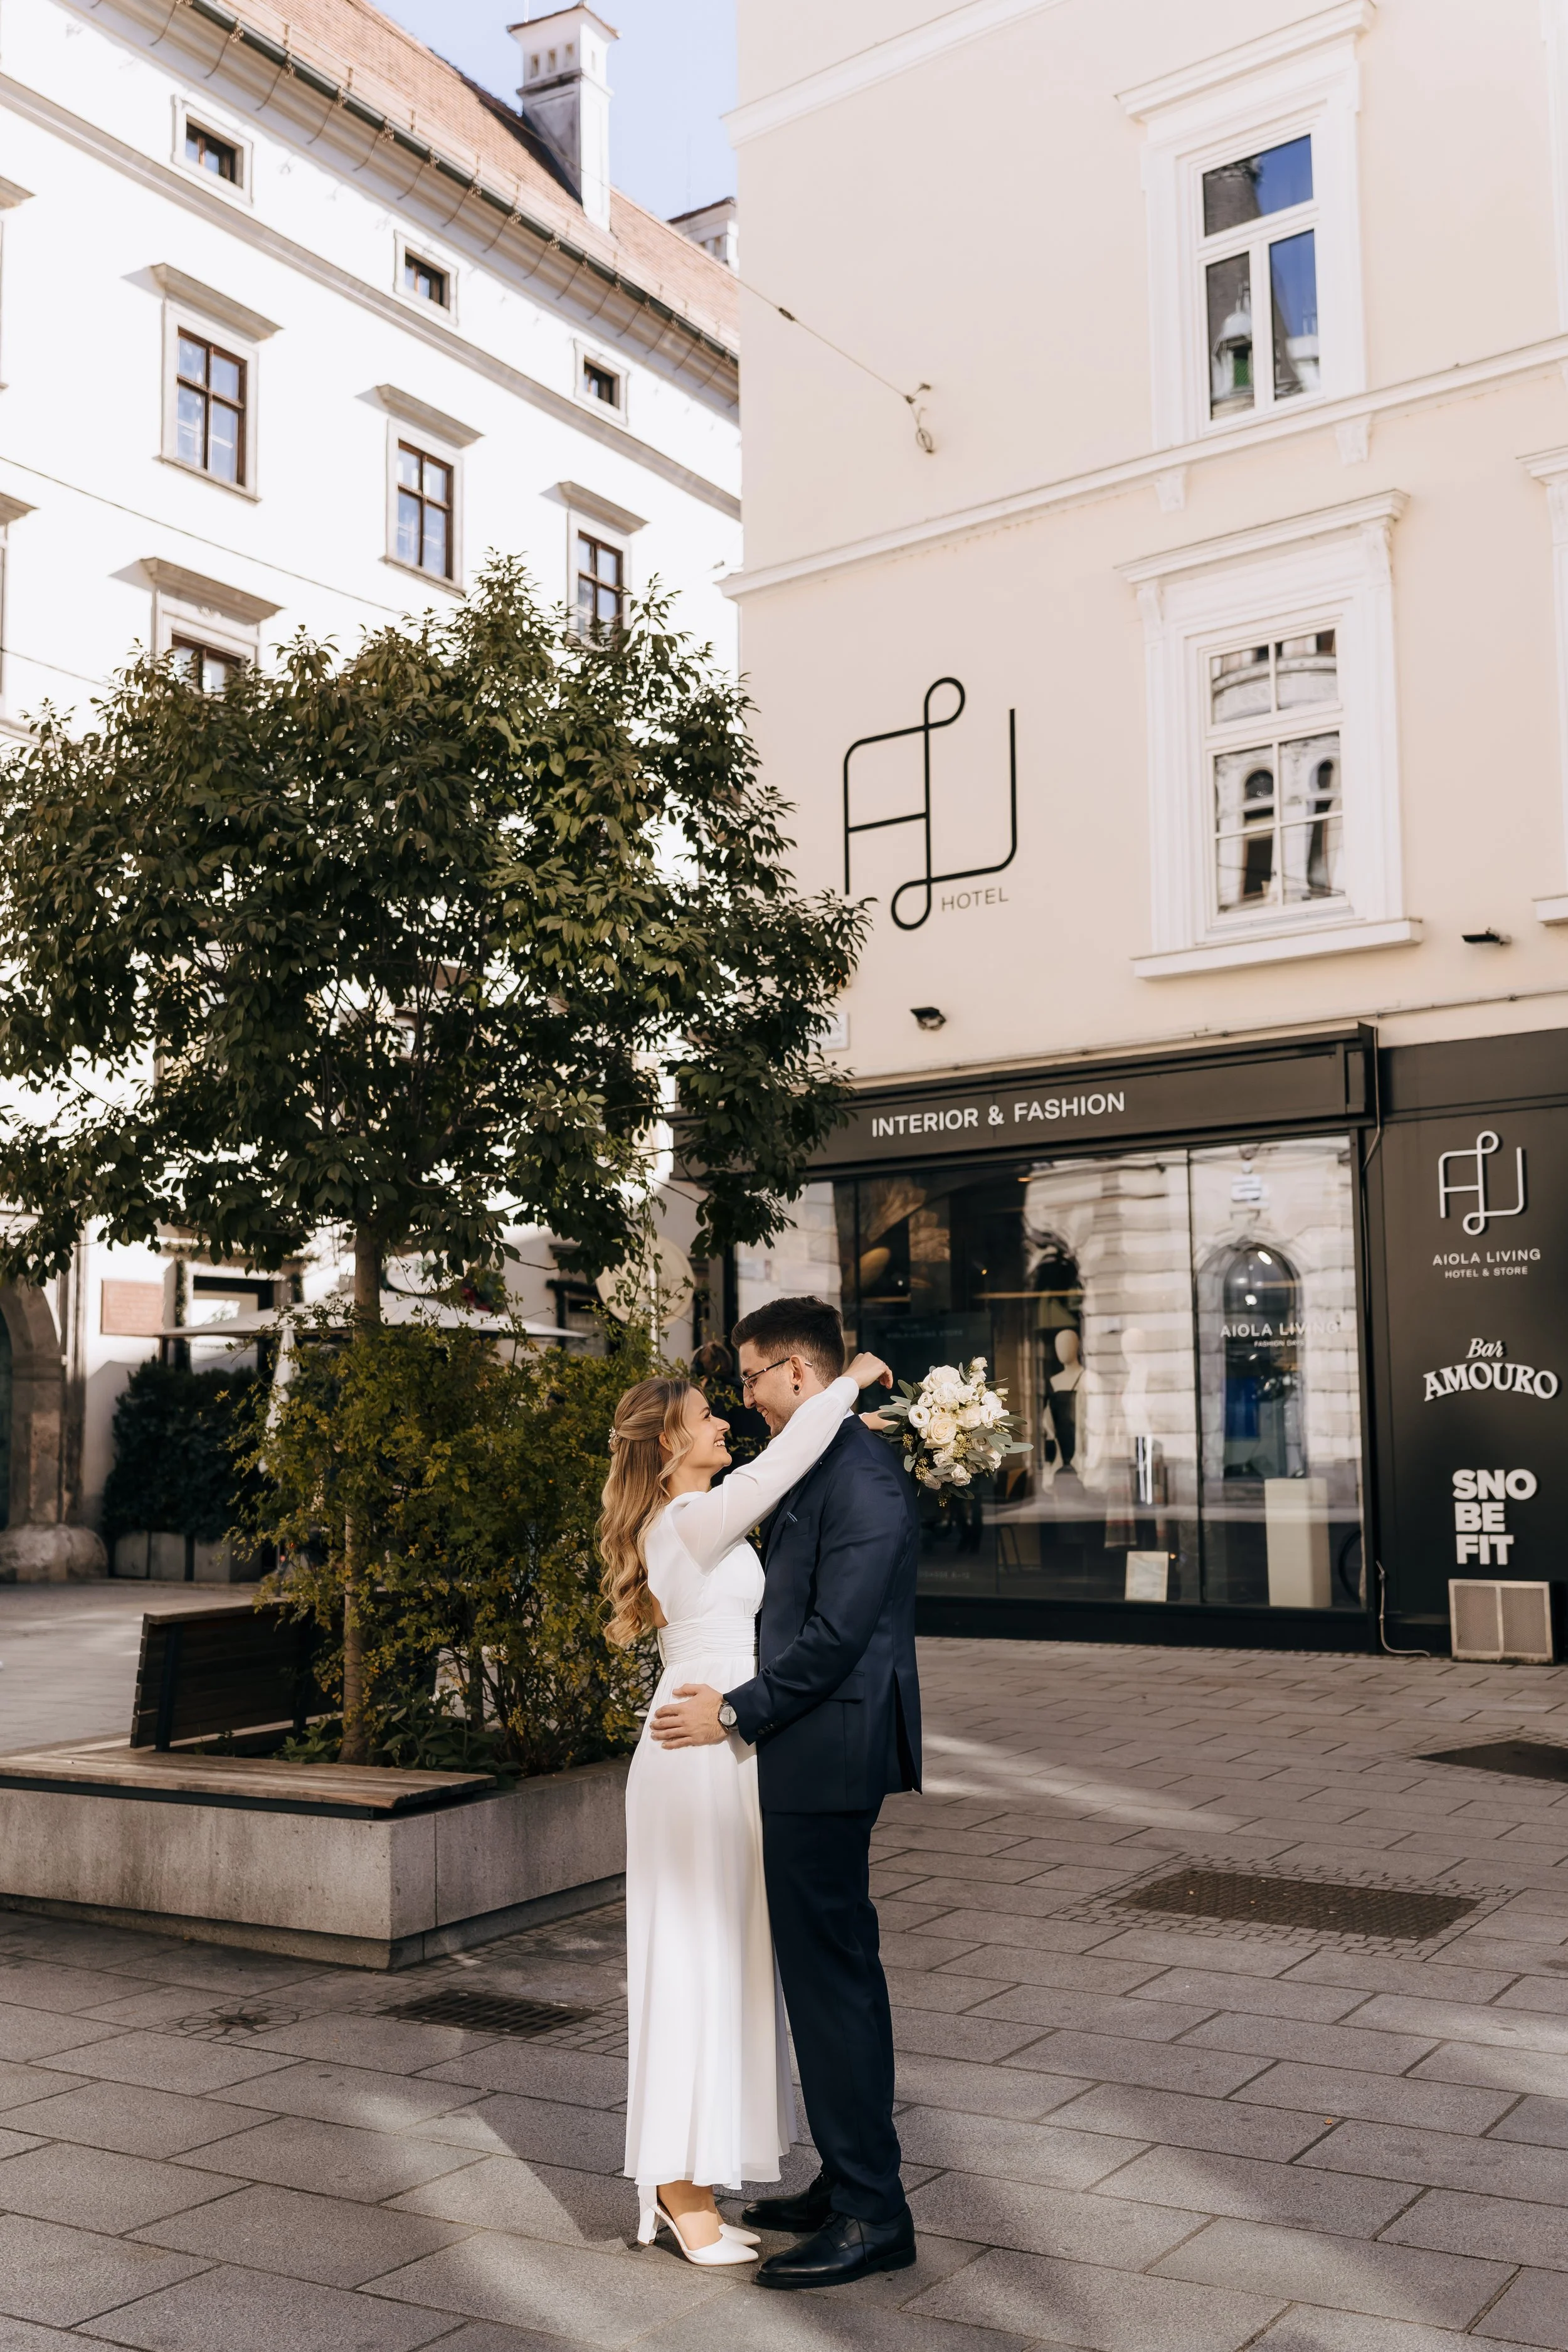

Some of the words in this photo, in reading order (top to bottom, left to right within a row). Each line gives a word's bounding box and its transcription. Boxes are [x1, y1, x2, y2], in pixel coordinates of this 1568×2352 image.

[941, 887, 1009, 913] HOTEL
[872, 1107, 978, 1137] INTERIOR
[987, 1105, 1005, 1125] &
[1014, 1091, 1125, 1122] FASHION
[1433, 1251, 1481, 1266] AIOLA
[1486, 1248, 1542, 1264] LIVING
[1444, 1269, 1479, 1279] HOTEL
[1482, 1269, 1490, 1278] &
[1494, 1266, 1528, 1277] STORE
[1220, 1323, 1273, 1338] AIOLA
[1279, 1322, 1339, 1336] LIVING
[1254, 1340, 1285, 1348] FASHION
[1466, 1338, 1503, 1359] Bar
[1422, 1362, 1559, 1402] AMOURO
[1452, 1469, 1538, 1500] SNO
[1454, 1502, 1506, 1533] BE
[1456, 1534, 1515, 1565] FIT
